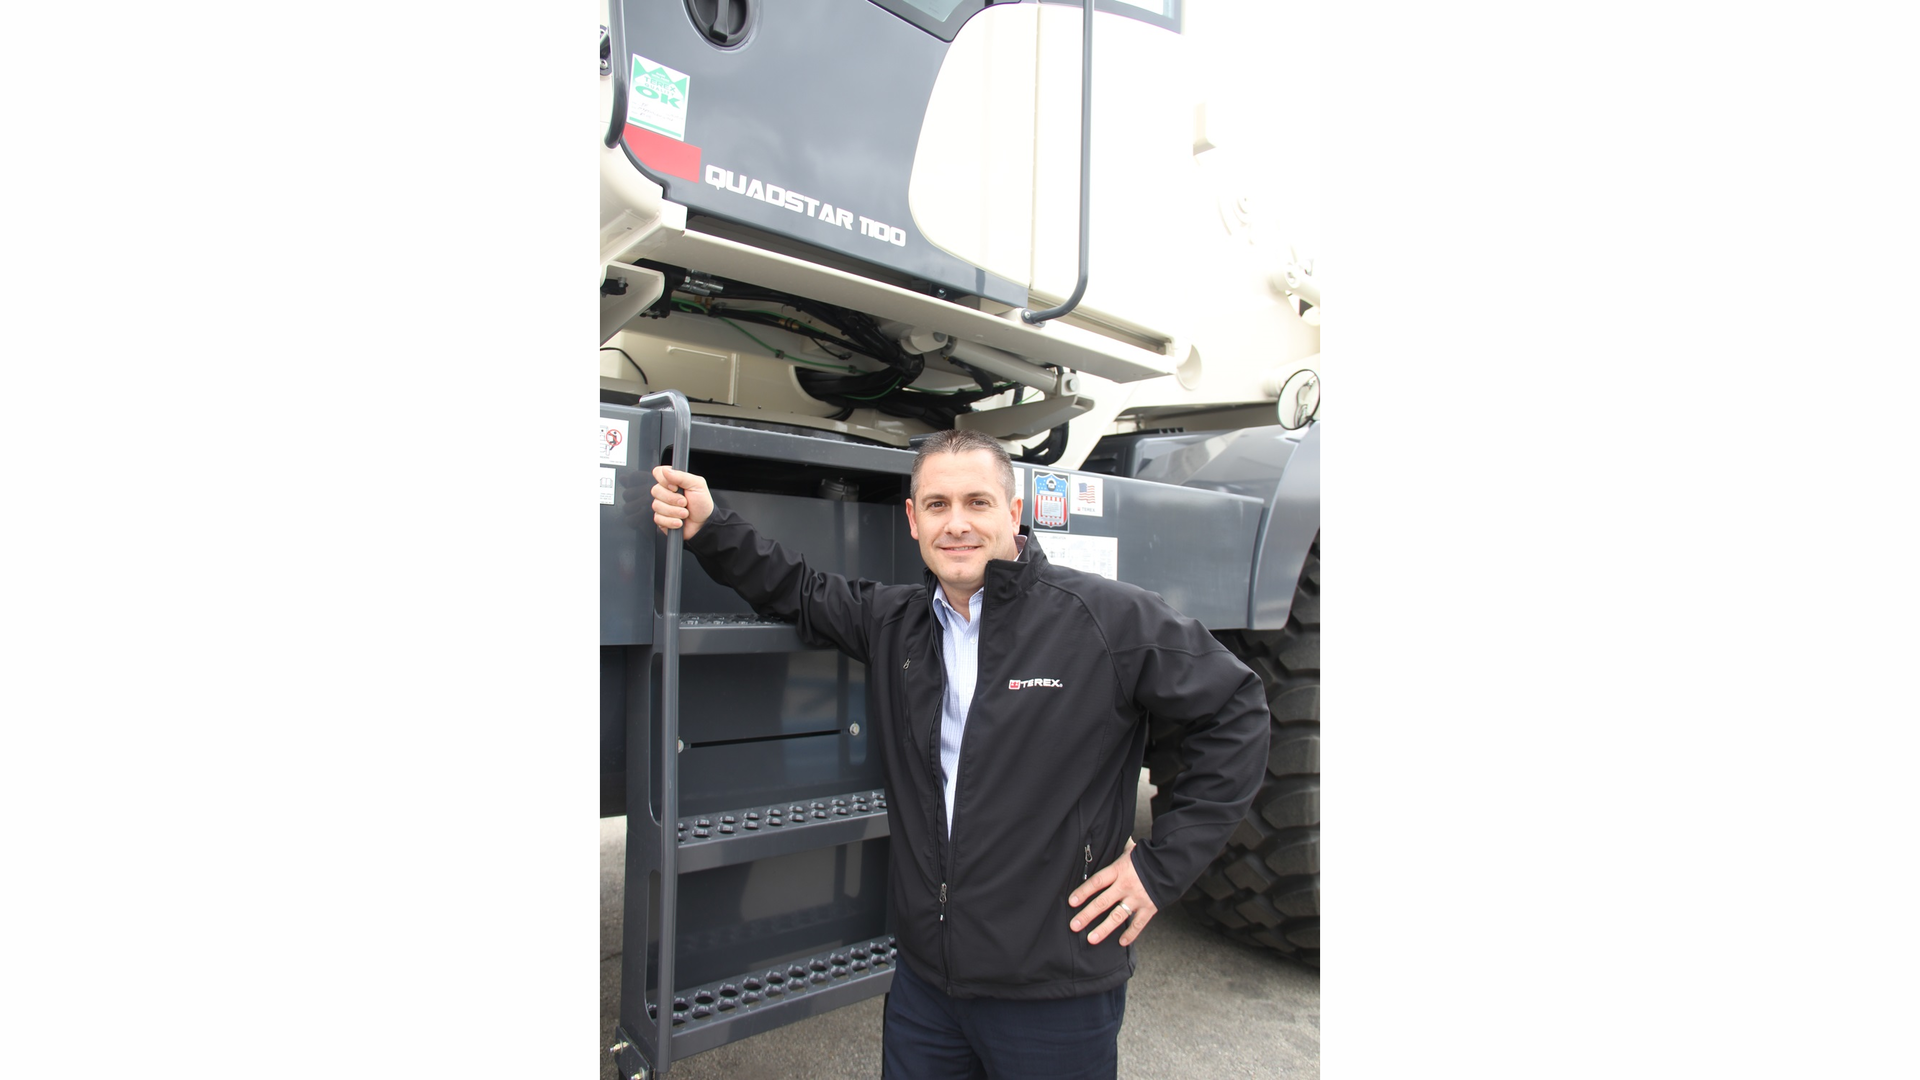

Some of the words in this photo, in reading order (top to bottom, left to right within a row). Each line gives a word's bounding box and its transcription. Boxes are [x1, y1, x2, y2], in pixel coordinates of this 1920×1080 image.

[644, 75, 676, 93] TEREX
[644, 82, 675, 96] QUALITY
[635, 85, 680, 109] OK
[705, 164, 854, 231] QUADSTAR
[859, 215, 907, 248] 1100
[1020, 678, 1060, 688] TEREX
